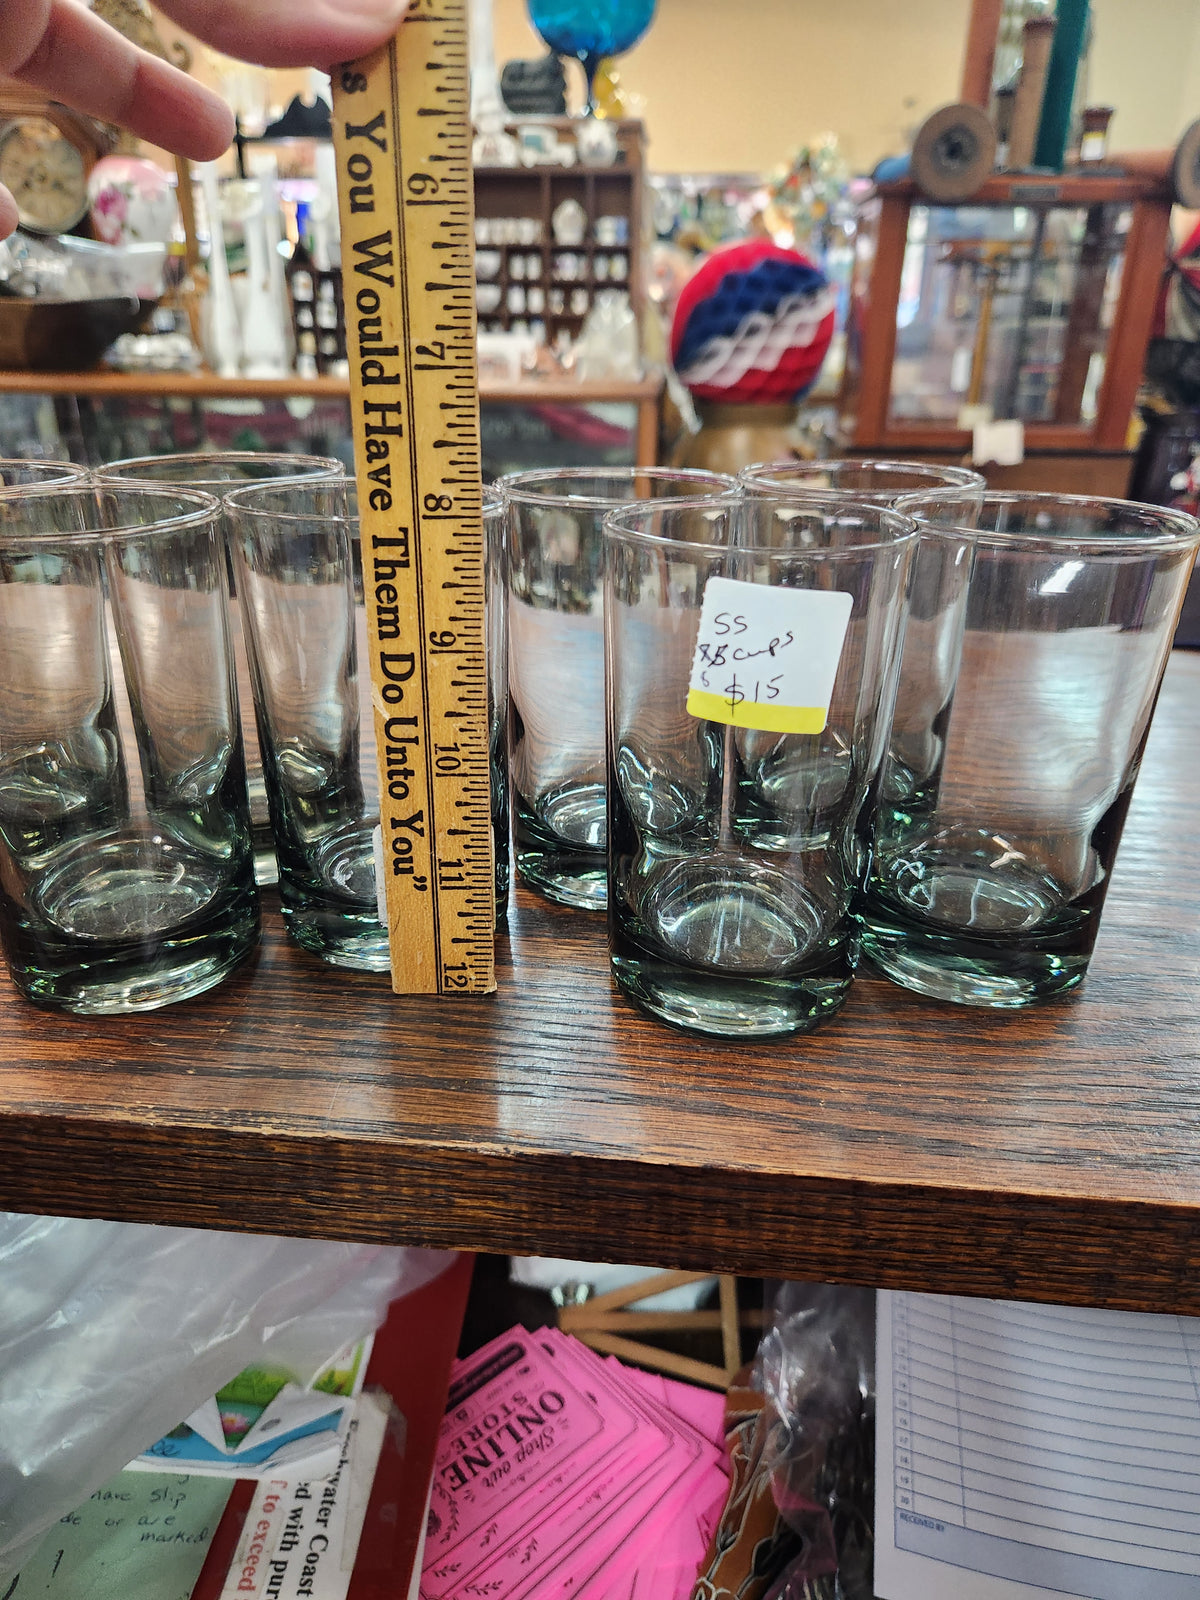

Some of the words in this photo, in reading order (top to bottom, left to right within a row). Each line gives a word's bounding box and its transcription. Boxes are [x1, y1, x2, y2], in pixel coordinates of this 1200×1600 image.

[345, 110, 388, 214] You
[353, 230, 400, 387] Would
[416, 341, 446, 361] 7
[363, 400, 403, 511] Have
[424, 494, 452, 514] 8
[372, 527, 409, 641] Them
[380, 652, 414, 703] Do
[724, 673, 784, 717] $15
[385, 716, 420, 800] Unto
[434, 742, 460, 770] 10
[437, 857, 464, 888] 11
[443, 961, 469, 988] 12
[440, 1390, 565, 1492] ONLINE
[450, 1391, 528, 1456] STORE
[514, 1425, 554, 1463] Shop
[482, 1460, 512, 1489] our
[137, 1515, 176, 1527] are
[262, 1494, 280, 1513] to
[140, 1527, 209, 1545] marked
[279, 1506, 304, 1552] with
[237, 1519, 271, 1592] exceed
[296, 1534, 329, 1597] Coast
[266, 1559, 289, 1600] pur
